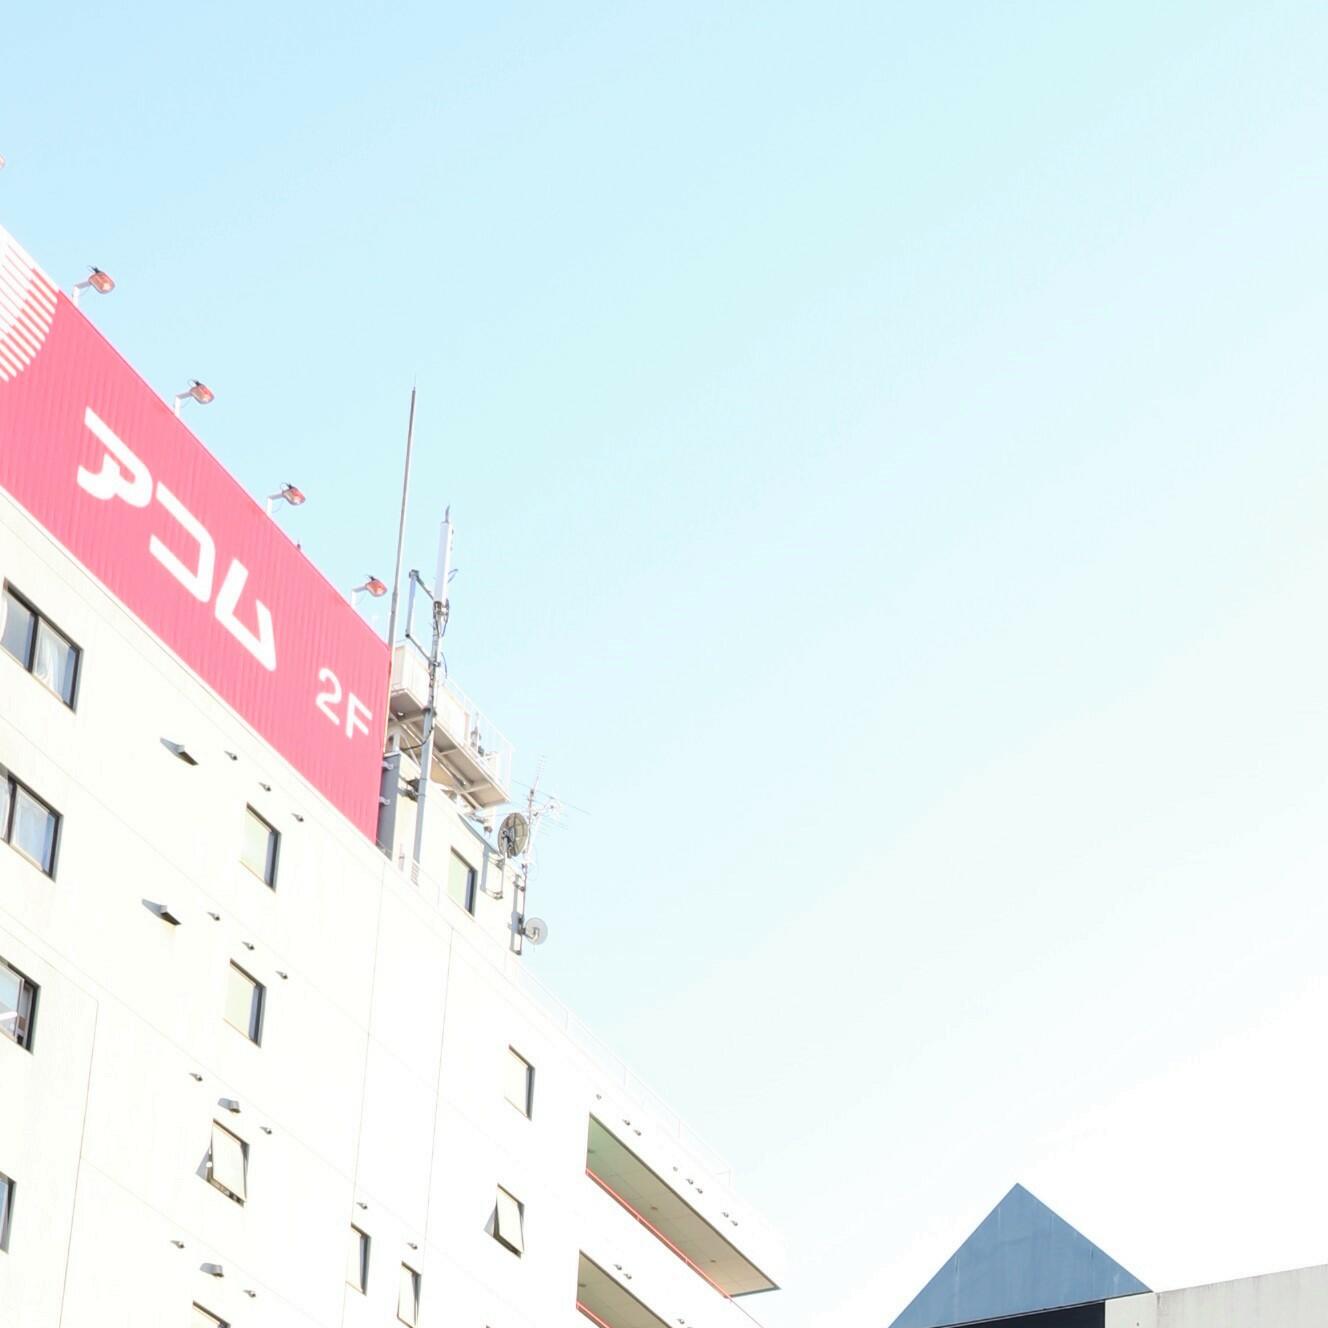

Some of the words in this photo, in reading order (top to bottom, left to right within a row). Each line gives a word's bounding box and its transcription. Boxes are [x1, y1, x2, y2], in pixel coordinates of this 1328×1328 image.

[76, 405, 276, 672] アコム
[314, 667, 373, 739] 2F
